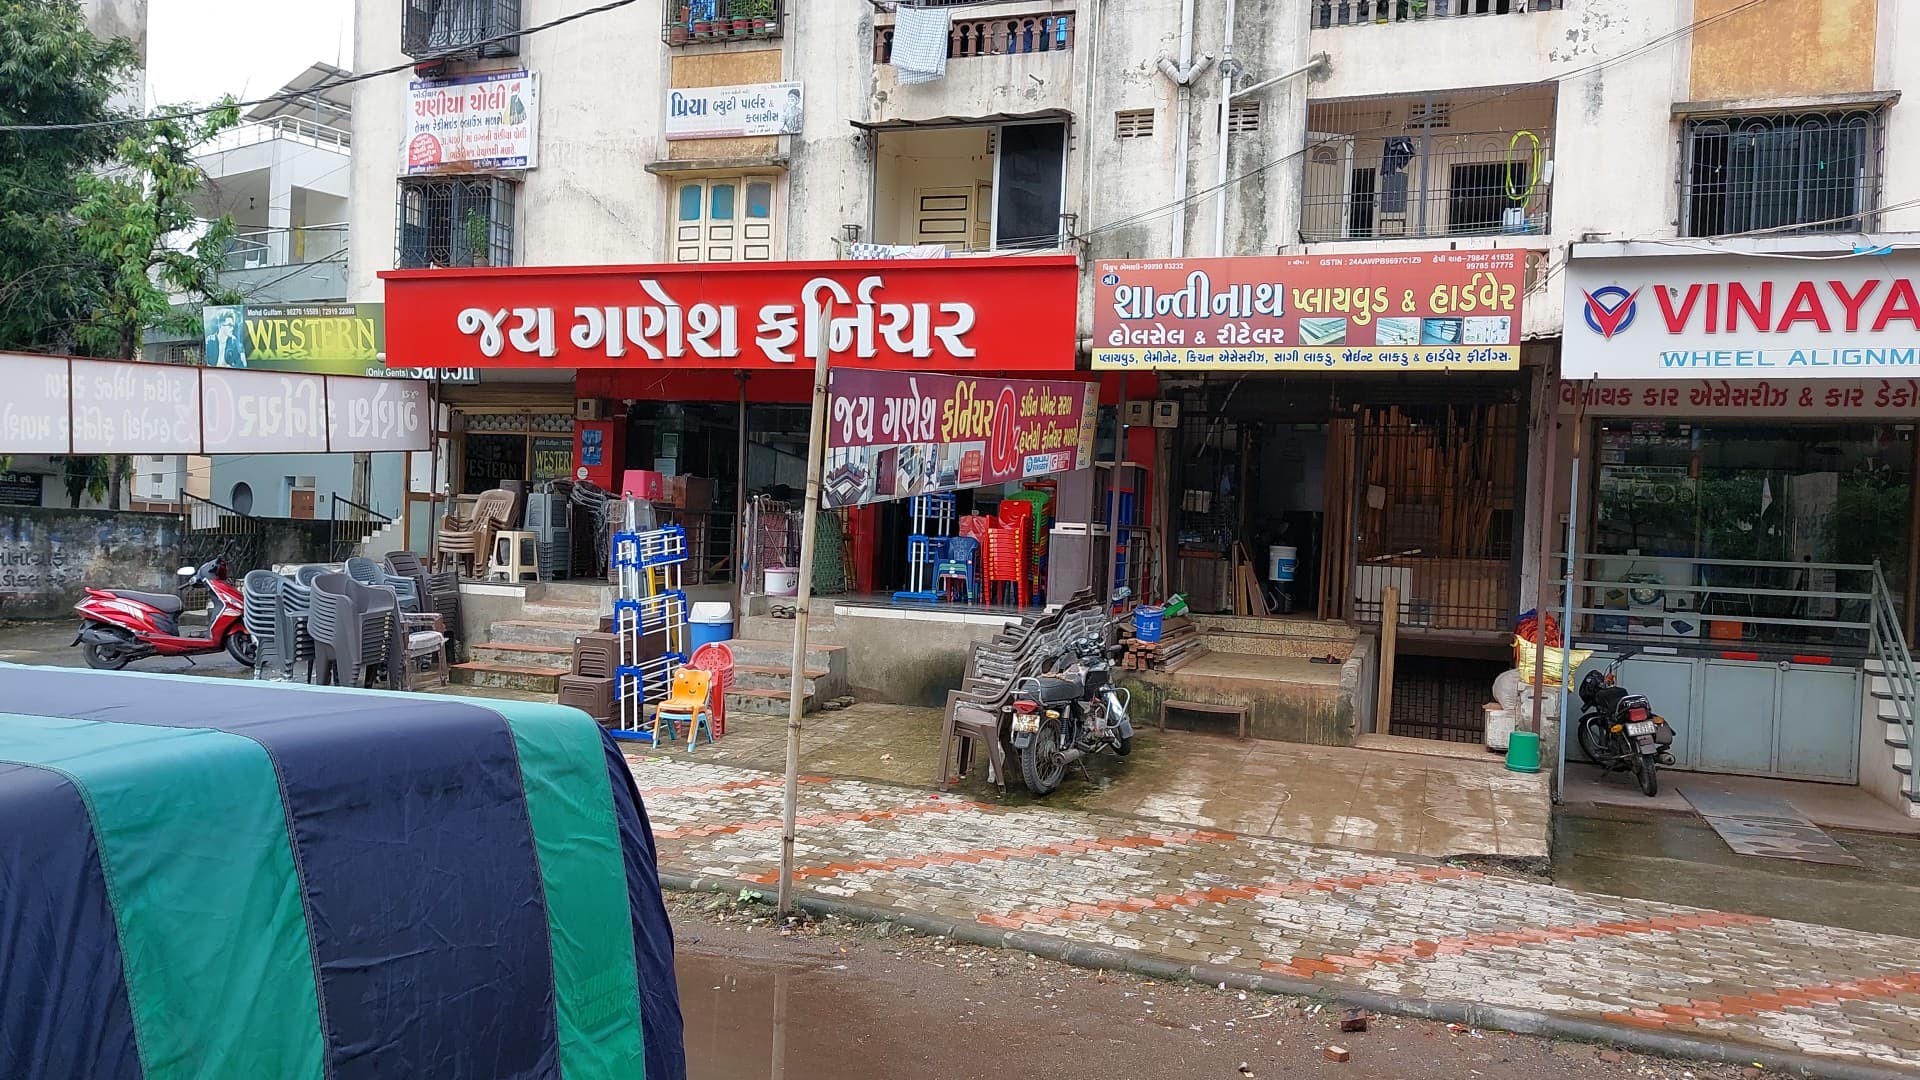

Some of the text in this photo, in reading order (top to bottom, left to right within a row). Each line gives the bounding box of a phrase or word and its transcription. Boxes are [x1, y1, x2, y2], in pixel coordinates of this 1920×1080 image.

[415, 89, 465, 117] ચણીયા
[470, 82, 506, 111] ચોલી
[671, 91, 707, 117] પ્રિયા
[712, 96, 737, 116] બ્યુટી
[741, 93, 765, 109] પાર્લર
[1113, 270, 1516, 326] શાન્તીનાથ પ્લાયવુડ & હાર્ડવેર
[457, 275, 977, 363] જય ગણેશ ફર્નિચર
[245, 317, 376, 351] WESTERN
[1108, 322, 1285, 346] હોલસેલ & રીટેલર
[1099, 351, 1139, 367] પ્લાયવુડ,
[1144, 349, 1181, 364] લેમીનેટ,
[1186, 349, 1214, 363] કિચન
[1219, 349, 1268, 364] એસેસરીઝ,
[1273, 349, 1299, 362] સાગી
[1413, 353, 1420, 362] &
[1425, 348, 1461, 363] હાર્ડવેર
[1661, 350, 1776, 367] WHEEL
[1020, 387, 1038, 417] ડાઉન
[1058, 395, 1072, 416] સરળ
[1643, 387, 1680, 407] કાર
[1688, 379, 1789, 408] એસેસરીઝ
[1799, 386, 1814, 407] &
[1825, 386, 1864, 408] કાર
[834, 396, 875, 443] જય
[882, 377, 937, 442] ગણેશ
[941, 380, 994, 443] ફર્નિચર
[1041, 420, 1062, 454] ફર્નિચર
[464, 458, 518, 479] ESTERN
[535, 450, 573, 472] WESTER
